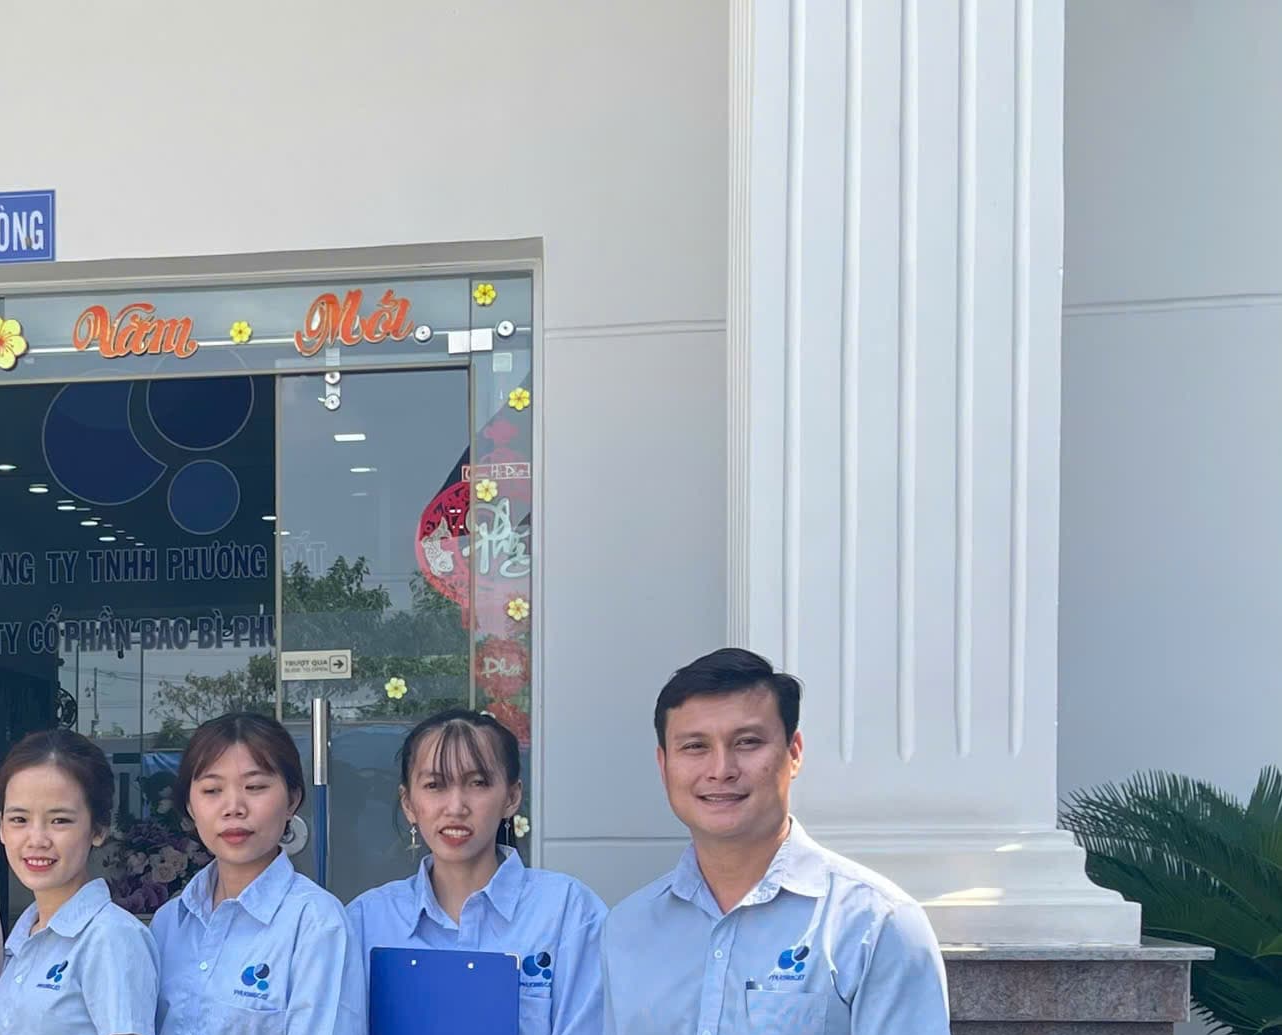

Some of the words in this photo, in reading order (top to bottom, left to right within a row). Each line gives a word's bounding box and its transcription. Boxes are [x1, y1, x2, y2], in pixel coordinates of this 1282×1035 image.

[45, 551, 79, 584] TY
[86, 548, 157, 583] TNHH
[166, 540, 268, 581] PHƯƠNG
[27, 603, 62, 654] CỔ
[64, 605, 131, 653] PHẦN
[139, 616, 192, 650] BAO
